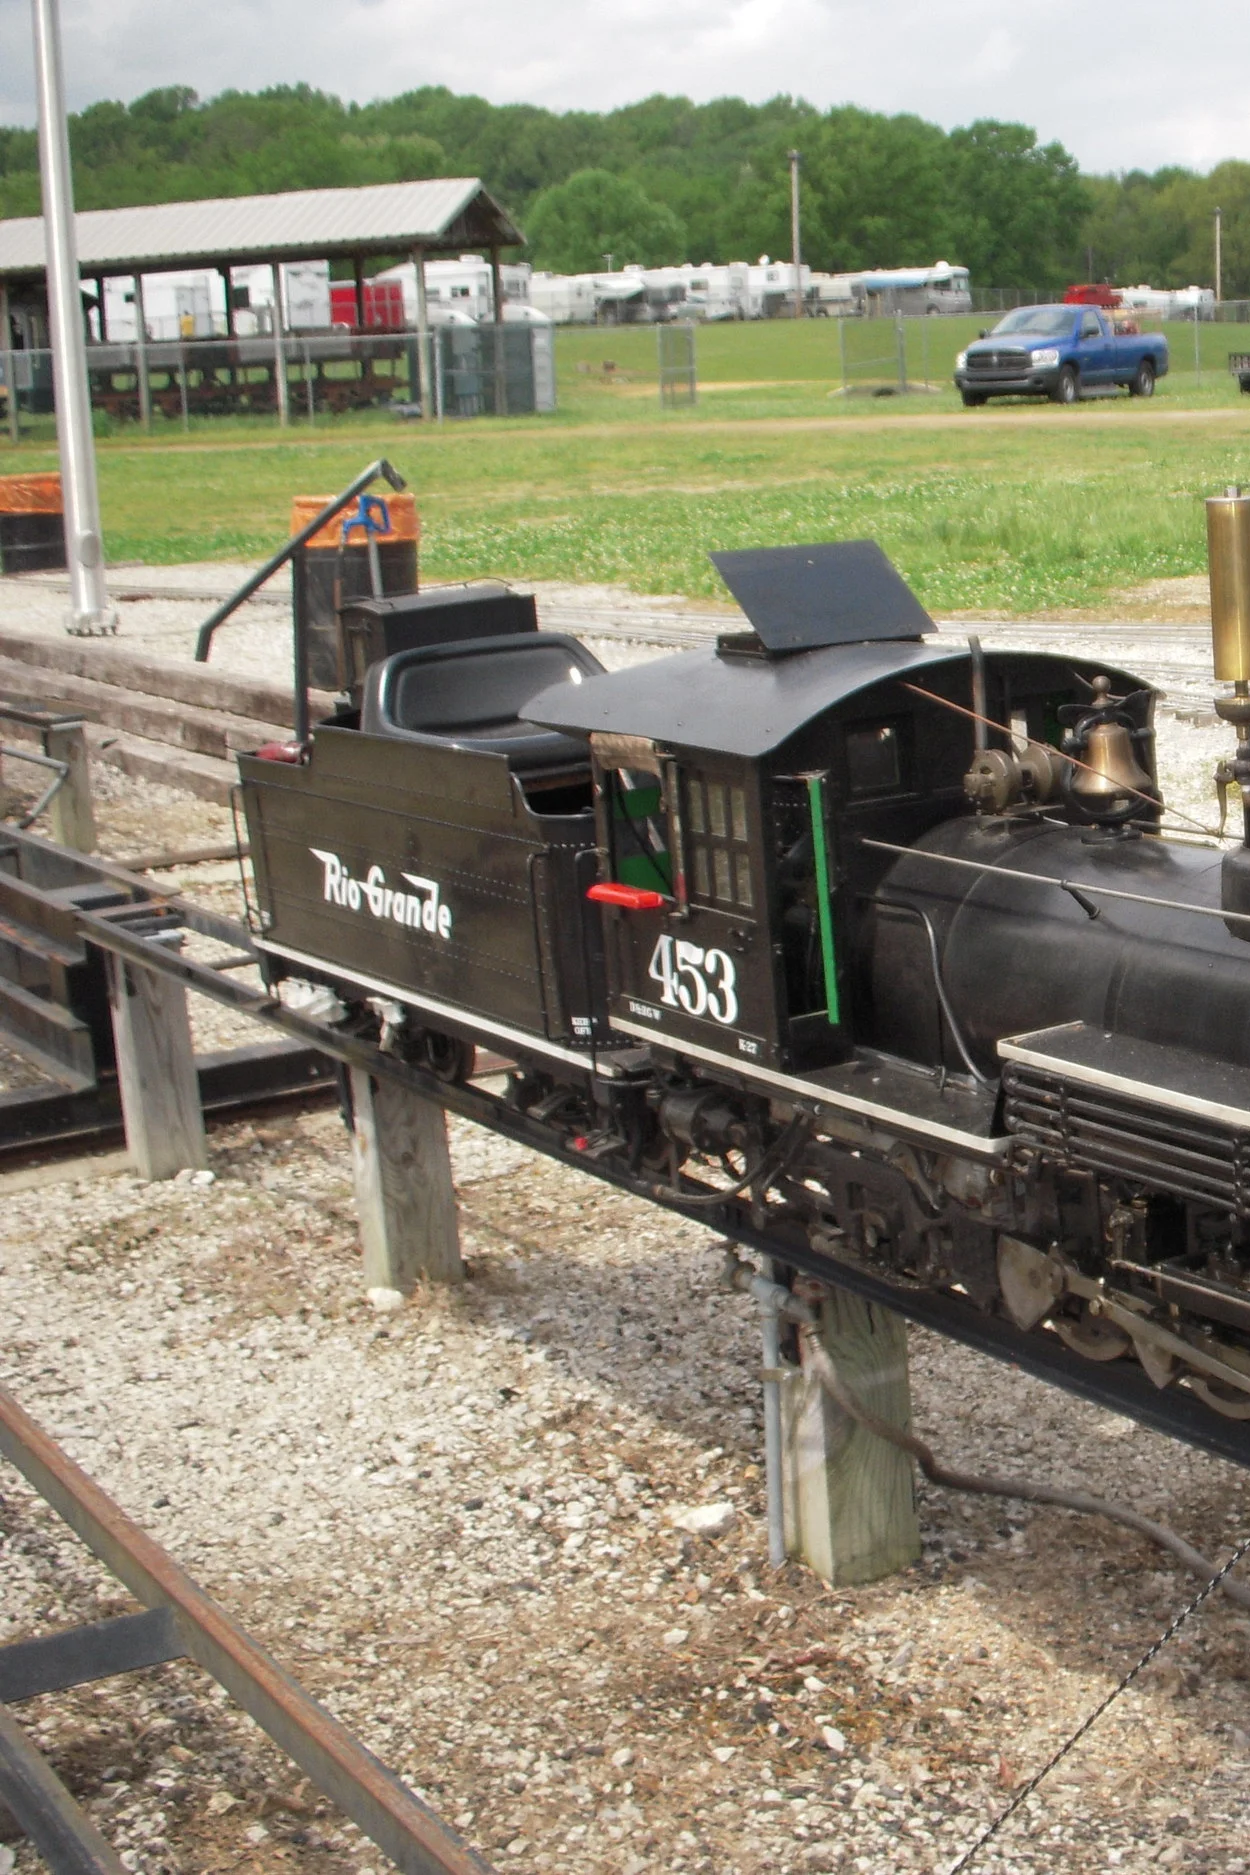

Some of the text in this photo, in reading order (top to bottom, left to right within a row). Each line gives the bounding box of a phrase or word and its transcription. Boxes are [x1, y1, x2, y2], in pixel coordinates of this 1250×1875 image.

[308, 847, 453, 940] Rio Grande
[648, 934, 739, 1025] 453
